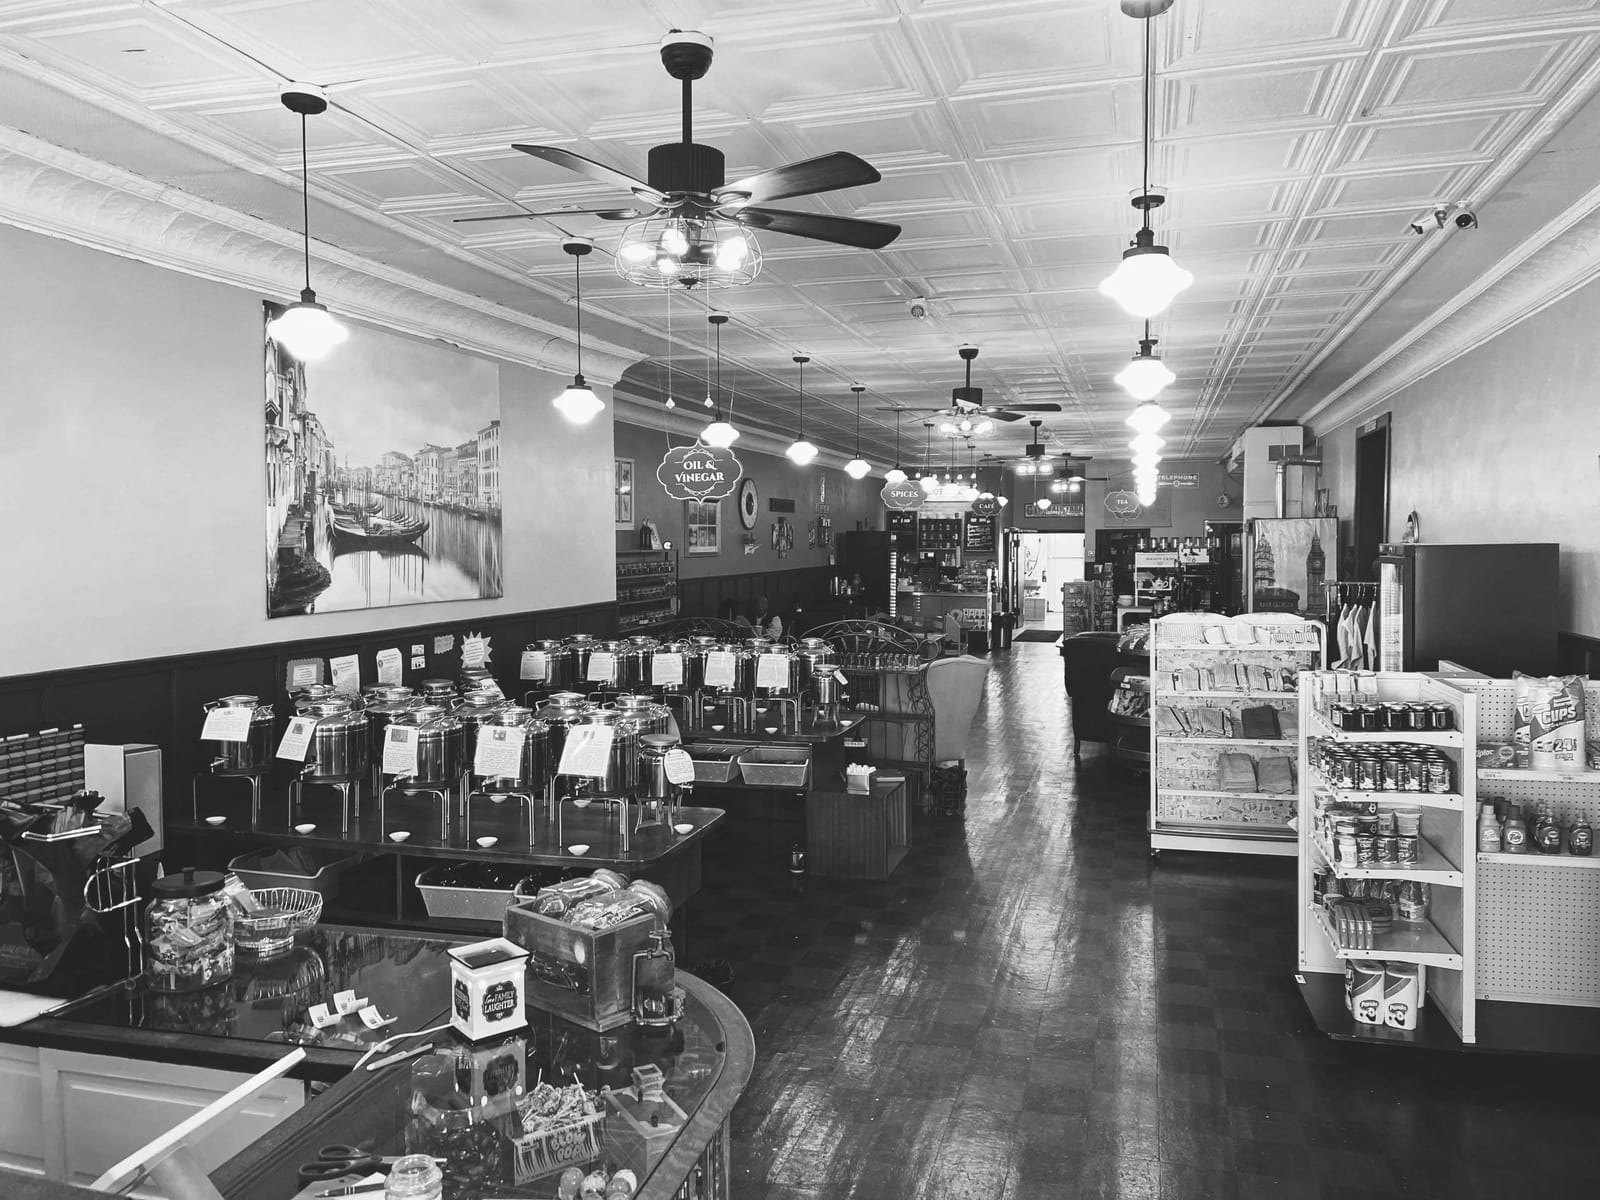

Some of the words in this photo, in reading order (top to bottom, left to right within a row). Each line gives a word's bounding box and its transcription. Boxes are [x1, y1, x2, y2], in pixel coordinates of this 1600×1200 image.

[683, 461, 703, 470] OIL
[705, 460, 718, 470] &
[675, 472, 724, 482] VINEGAR
[891, 490, 918, 498] SPICES
[1542, 706, 1576, 725] CUPS
[484, 999, 515, 1014] LAUGHTER
